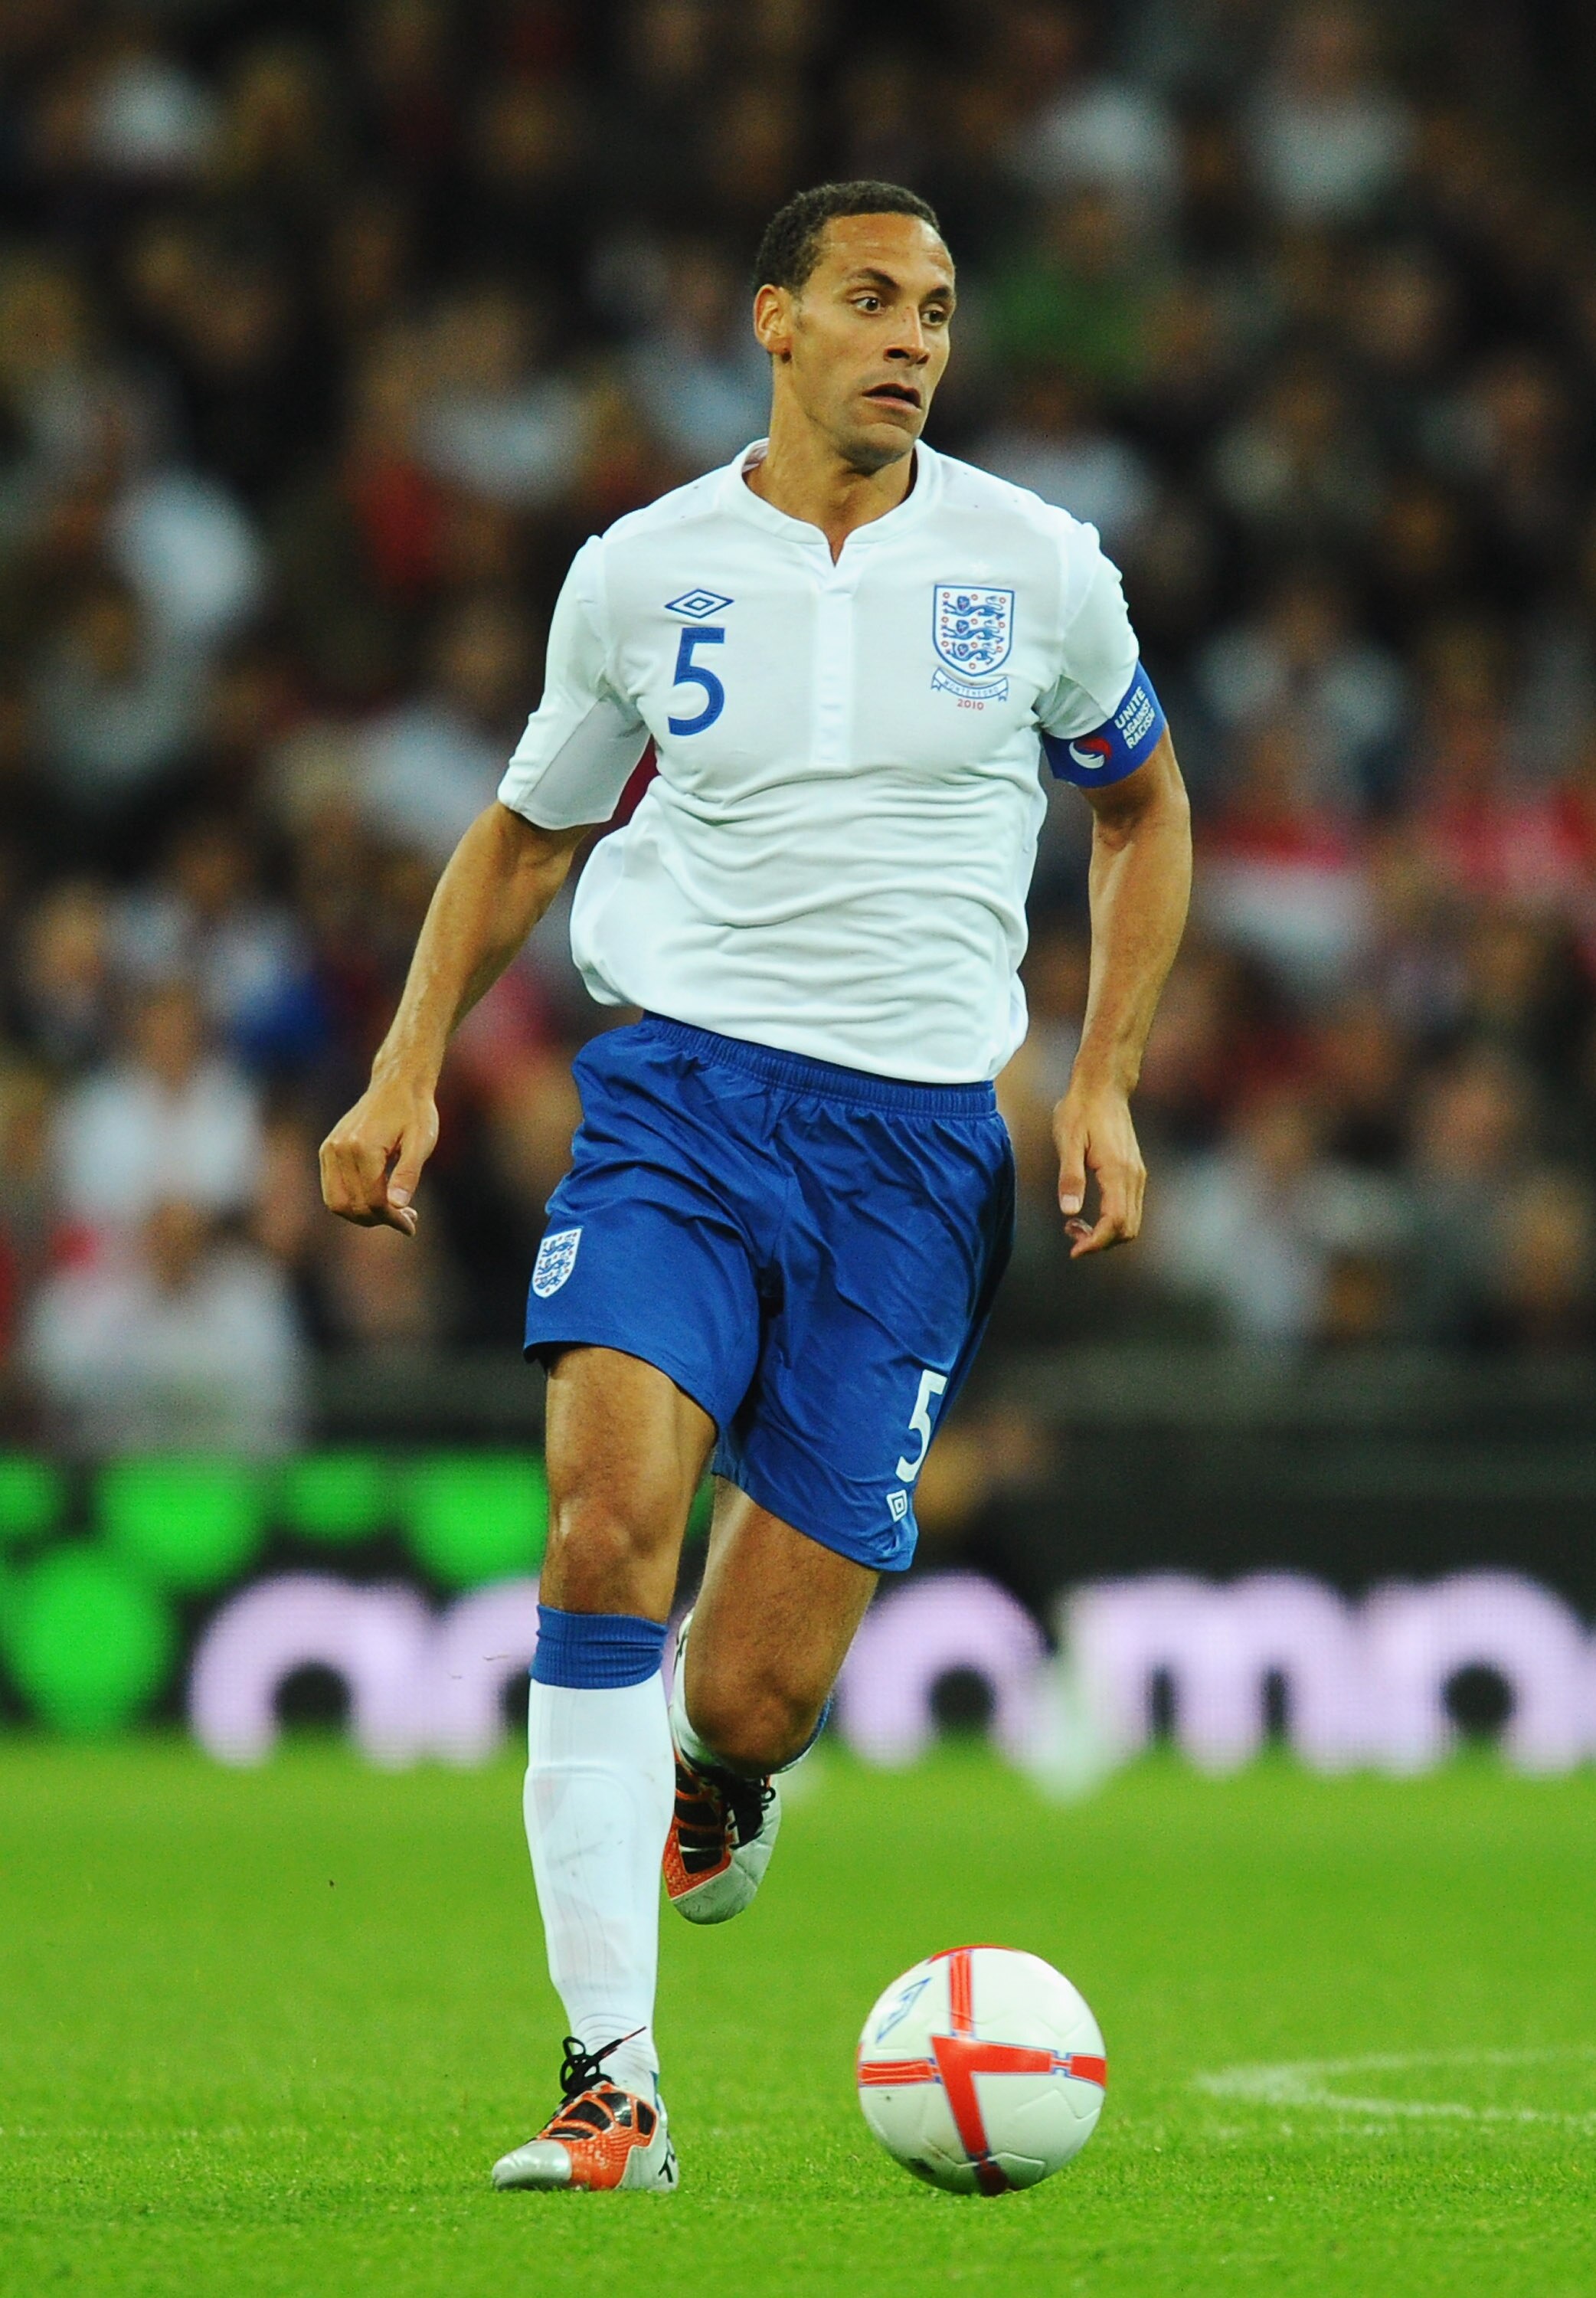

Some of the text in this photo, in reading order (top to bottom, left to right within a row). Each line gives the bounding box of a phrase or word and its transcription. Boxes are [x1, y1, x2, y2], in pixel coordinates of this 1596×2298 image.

[668, 627, 724, 735] 5
[957, 699, 984, 710] 2010
[1114, 686, 1146, 729] UNITE
[1122, 698, 1151, 740] AGAINST
[1126, 708, 1156, 749] RACISM
[895, 1369, 948, 1483] 5
